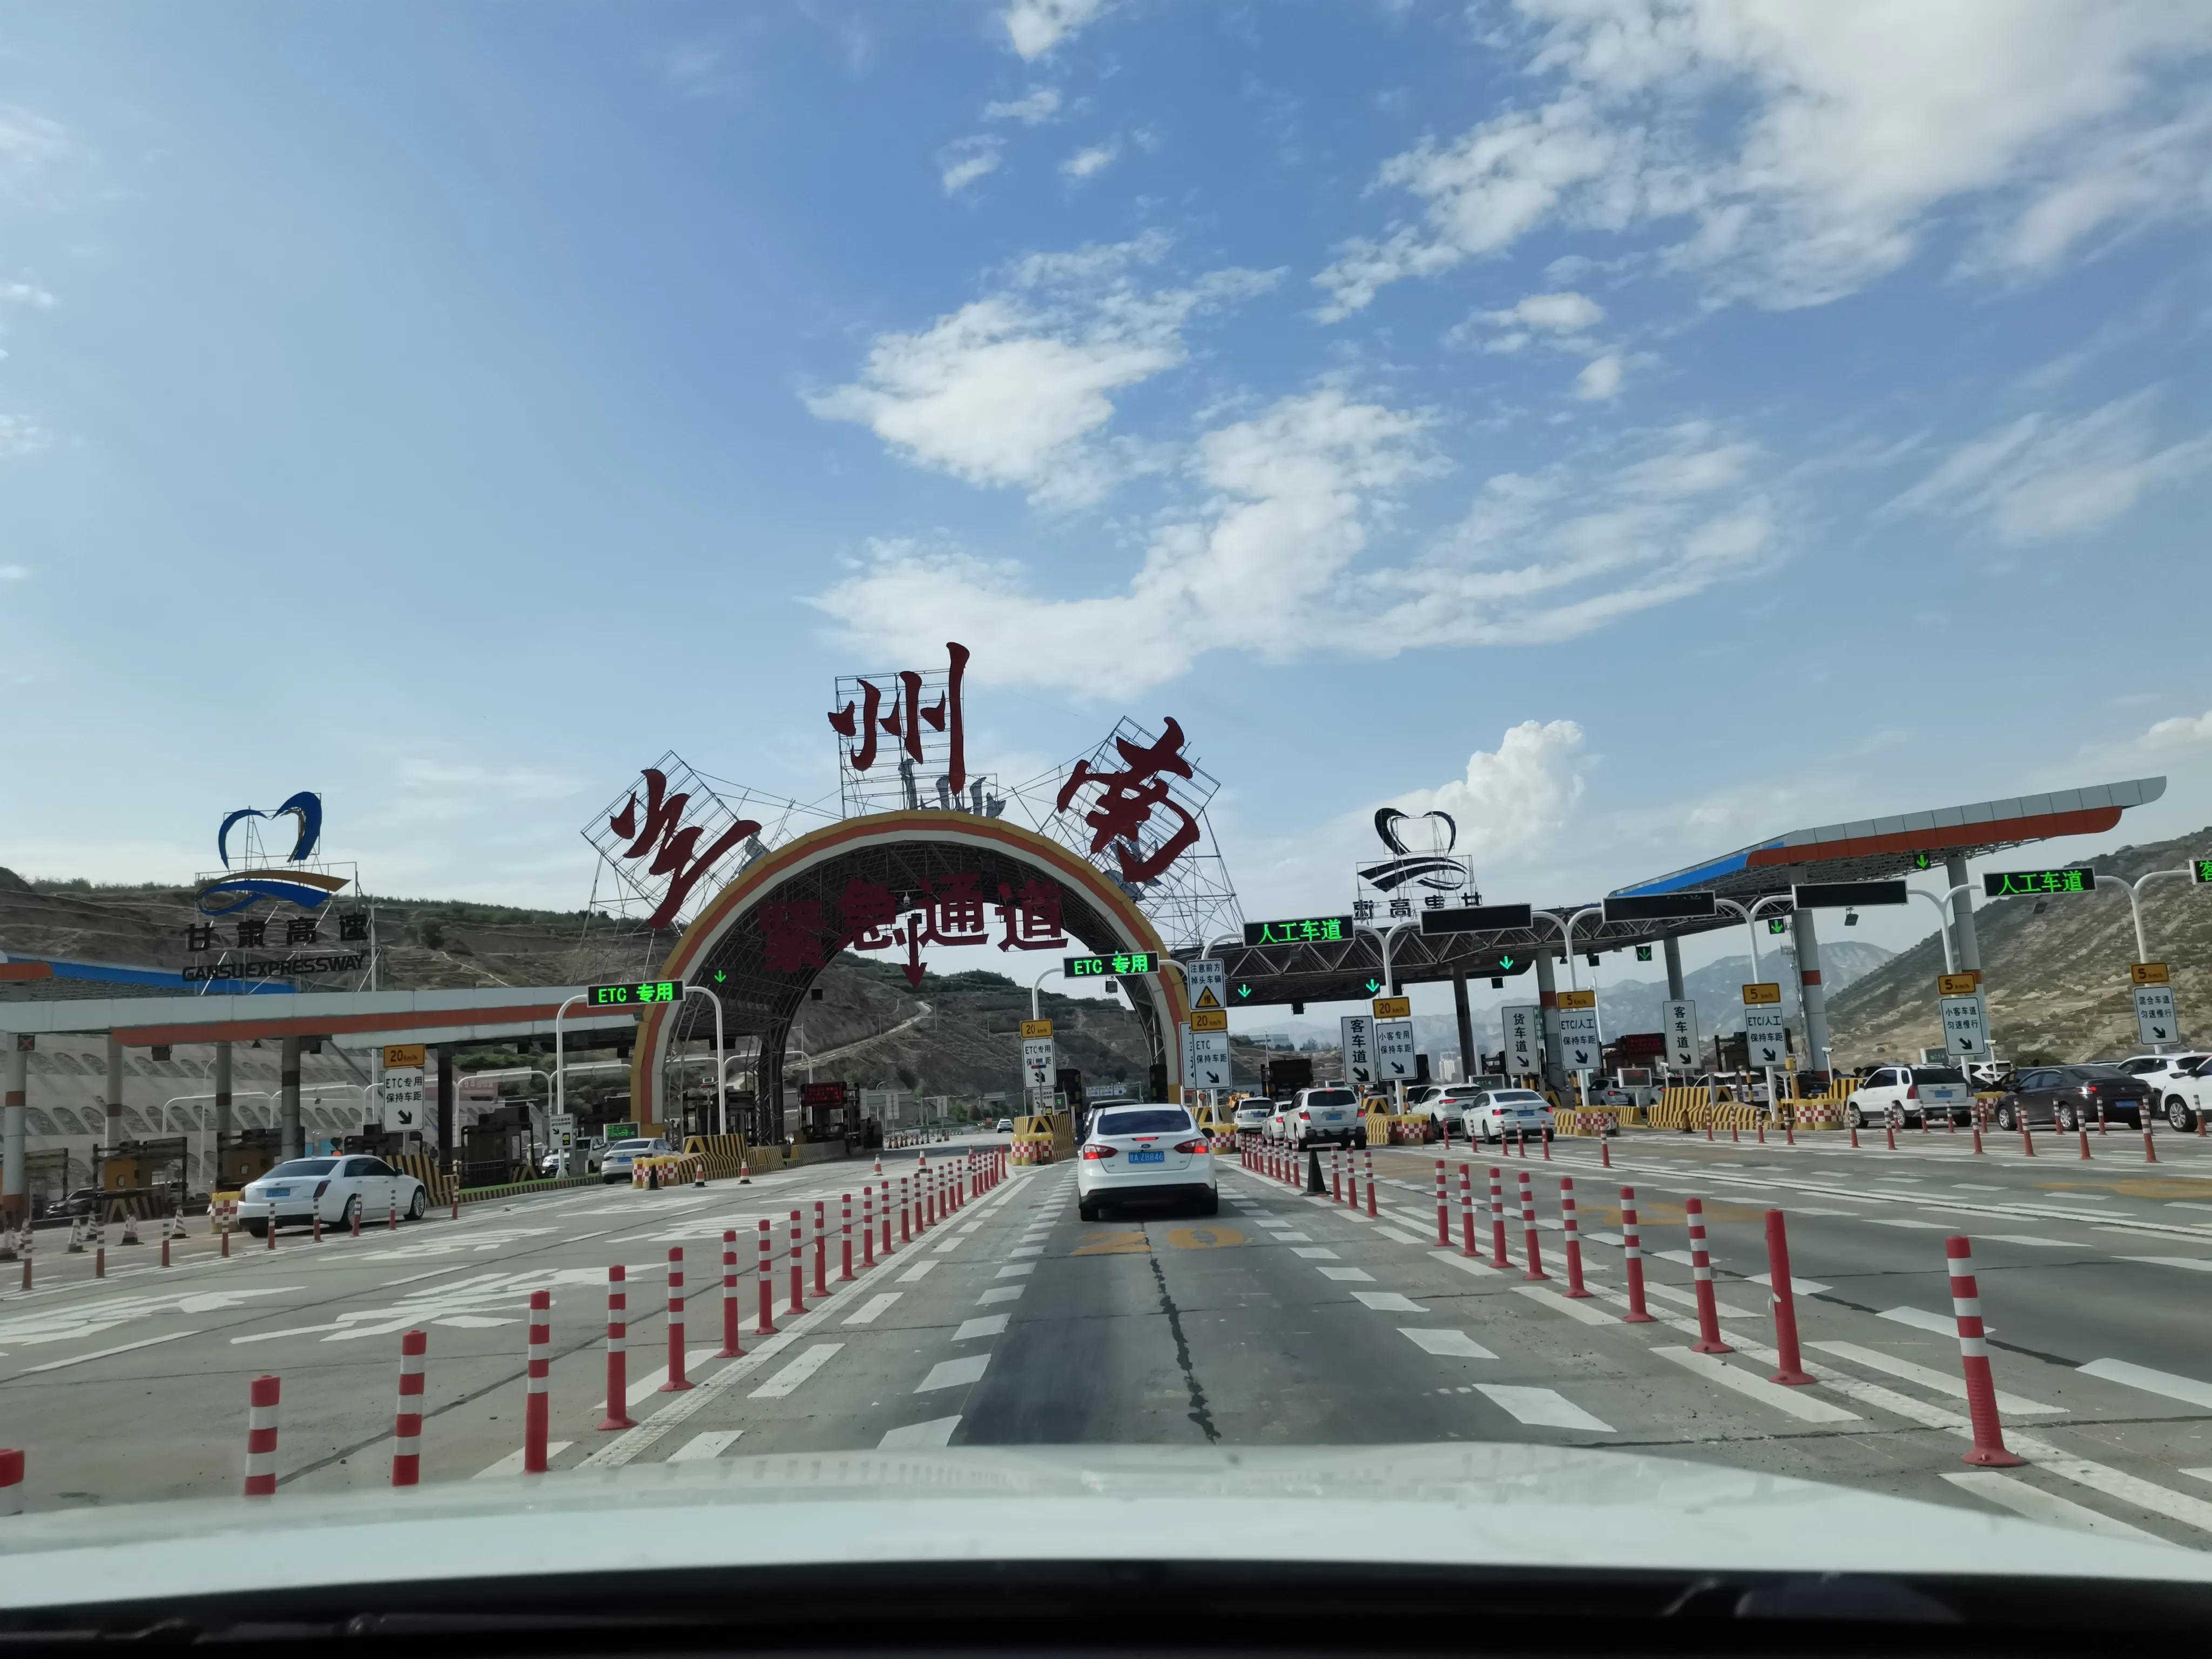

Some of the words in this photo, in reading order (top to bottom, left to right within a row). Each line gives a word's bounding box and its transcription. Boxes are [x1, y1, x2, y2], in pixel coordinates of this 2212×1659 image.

[1998, 870, 2083, 895] 人工车道
[757, 872, 1068, 972] 紧急通道
[185, 913, 368, 952] 甘肃高速
[1257, 919, 1343, 945] 人工车道
[1074, 959, 1102, 975] ETC
[1112, 954, 1148, 974] 专用
[1190, 963, 1220, 973] 注意前方
[2138, 968, 2146, 979] 5
[1191, 975, 1222, 985] 掉头车辆
[1945, 979, 1953, 990] 5
[598, 988, 626, 1003] ETC
[636, 983, 672, 1002] 专用
[1750, 989, 1758, 999] 5
[1567, 995, 1573, 1005] 5
[2139, 995, 2170, 1005] 混合车道
[1379, 1003, 1391, 1014] 20
[1946, 1006, 1977, 1016] 小客车道
[1197, 1016, 1208, 1026] 20
[1561, 1019, 1594, 1030] ETC/人工
[1748, 1016, 1781, 1026] ETC/人工
[1947, 1020, 1978, 1029] 匀速慢行
[1513, 1013, 1527, 1052] 货车道
[1674, 1007, 1689, 1048] 客车道
[1351, 1019, 1367, 1063] 客车道
[1379, 1030, 1410, 1041] 小客专用
[1563, 1036, 1596, 1046] 保持车距
[1750, 1033, 1783, 1042] 保持车距
[1196, 1040, 1210, 1050] ETC
[1380, 1044, 1412, 1054] 保持车距
[1197, 1054, 1228, 1063] 保持车距
[386, 1091, 422, 1103] 保持车距
